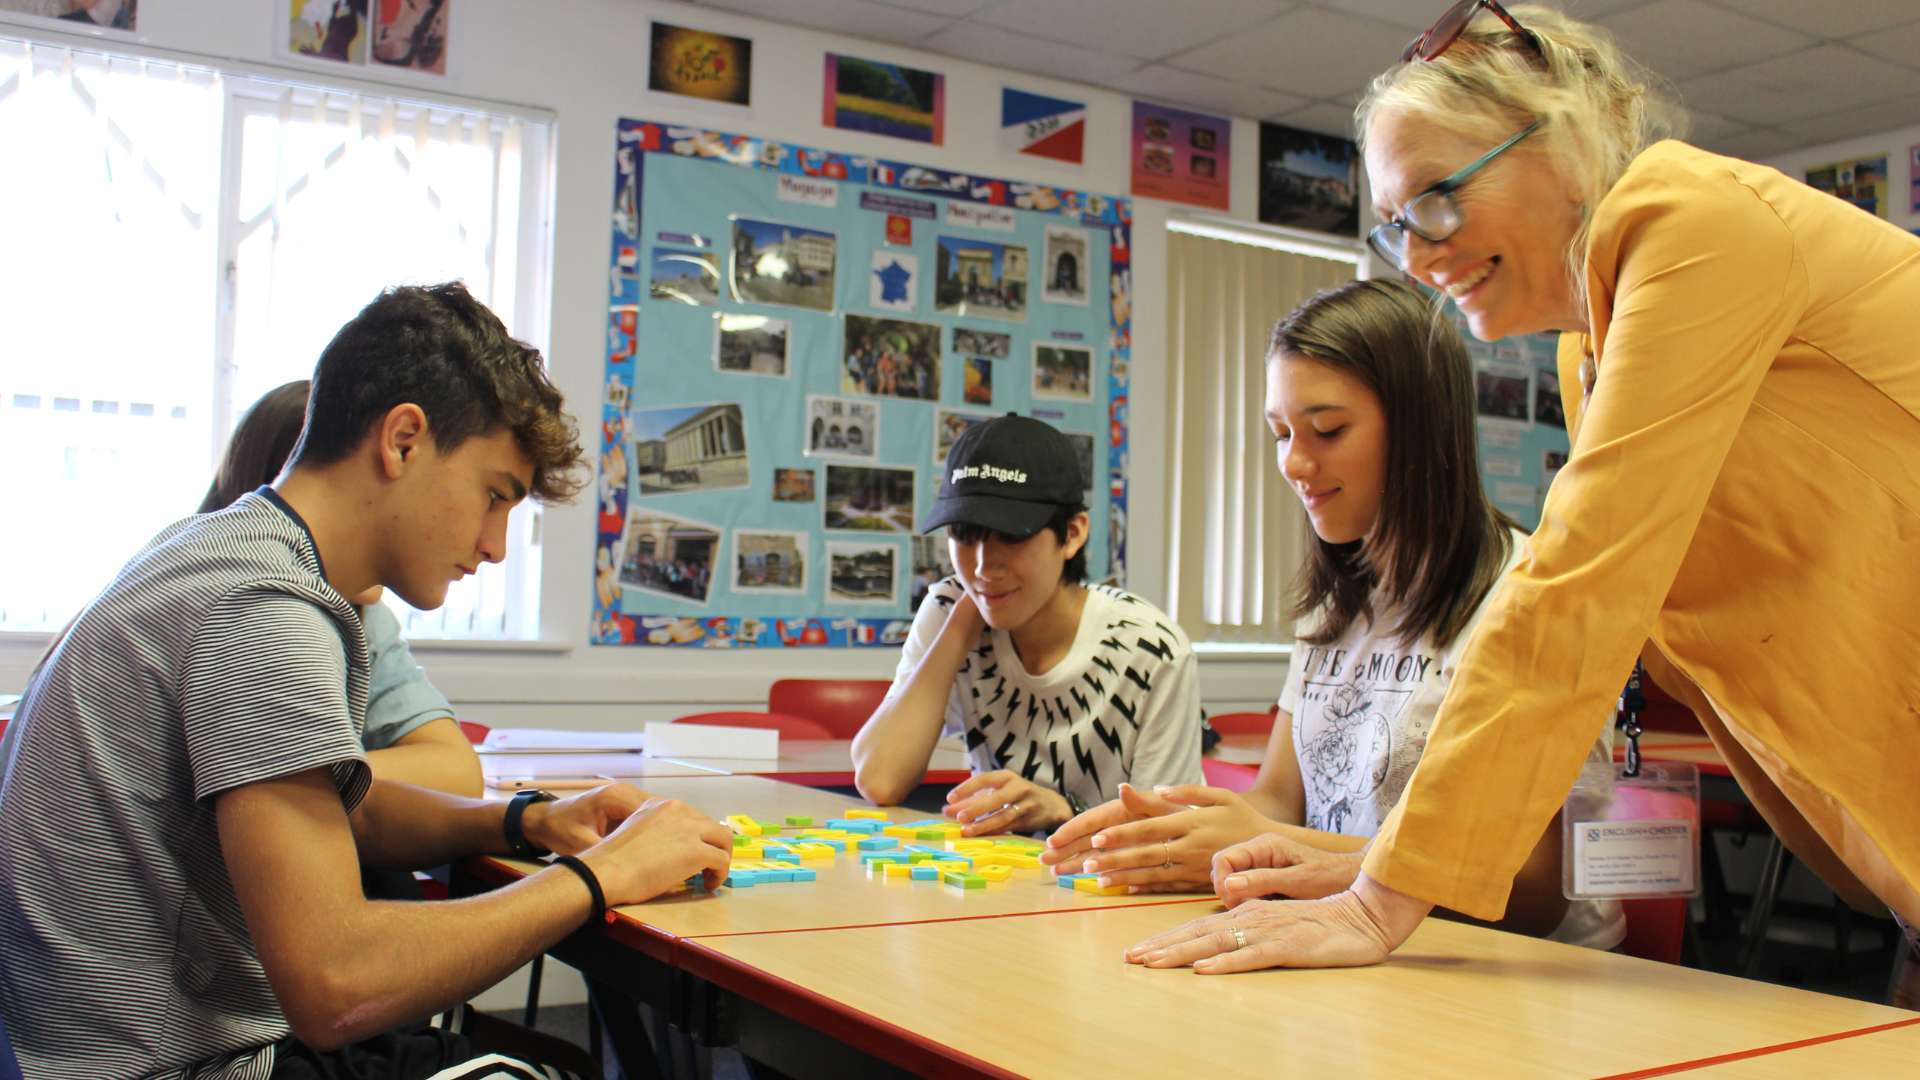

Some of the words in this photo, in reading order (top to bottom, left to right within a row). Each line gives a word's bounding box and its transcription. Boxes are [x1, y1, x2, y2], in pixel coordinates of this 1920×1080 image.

[980, 463, 1028, 483] Angels
[1303, 647, 1347, 677] THE
[1367, 652, 1433, 682] MOON
